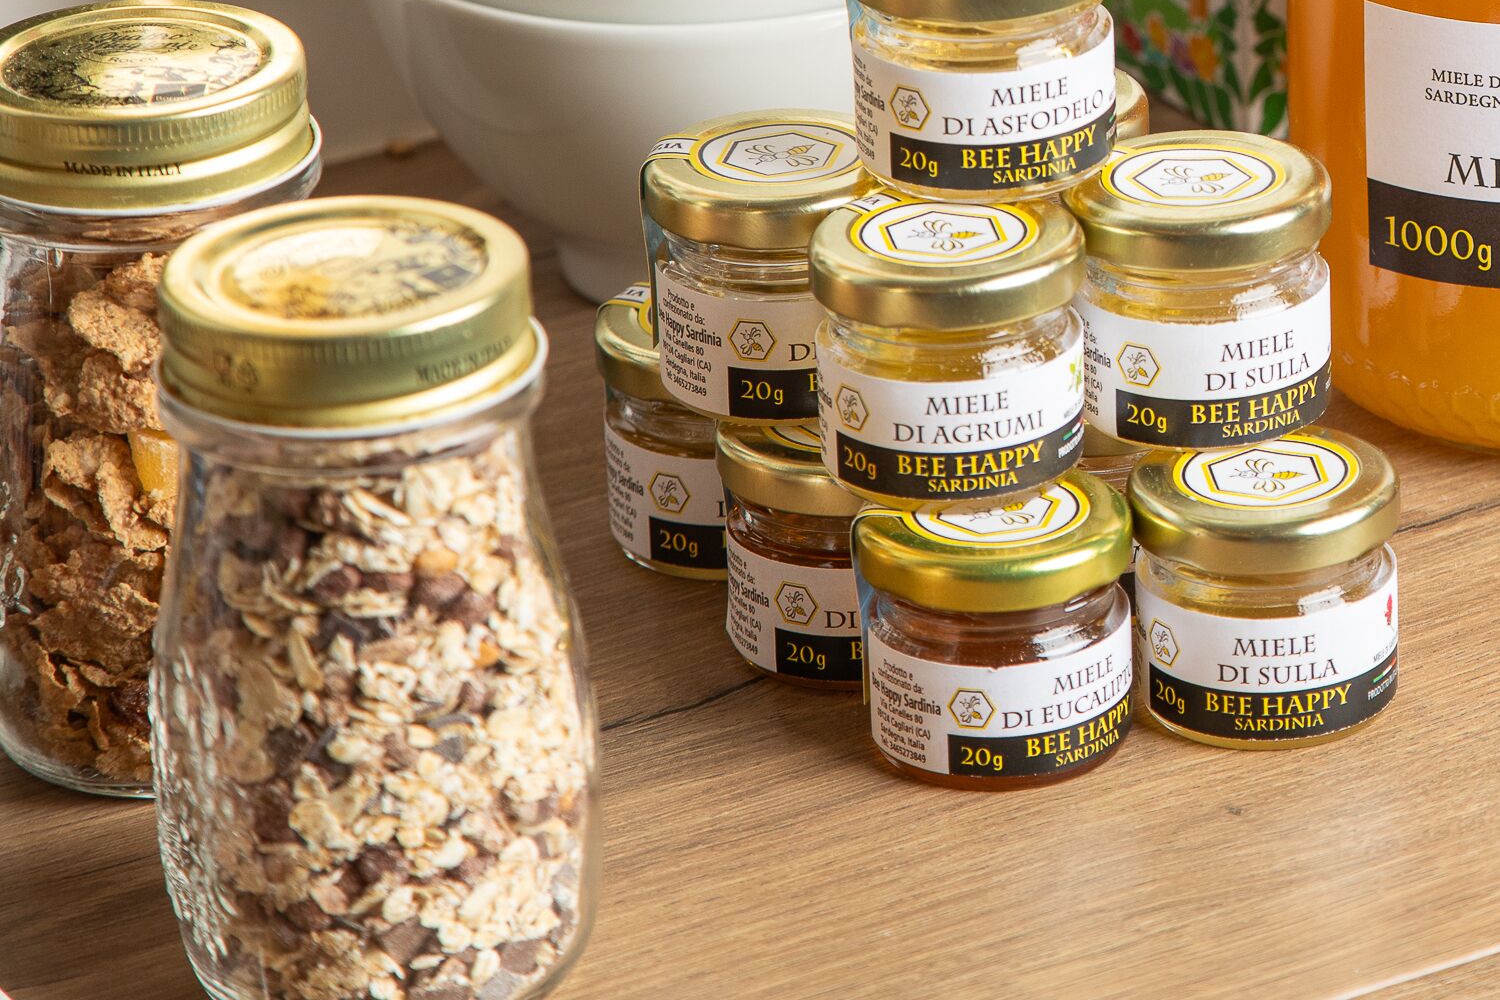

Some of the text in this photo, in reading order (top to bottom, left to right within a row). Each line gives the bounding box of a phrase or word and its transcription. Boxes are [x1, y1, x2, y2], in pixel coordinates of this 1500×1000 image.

[990, 76, 1068, 107] MIELE
[1431, 68, 1484, 88] MIELE
[943, 116, 973, 136] DI
[982, 89, 1104, 137] ASFODELO
[900, 147, 938, 177] 20g
[961, 147, 1011, 169] BEE
[1020, 124, 1097, 164] HAPPY
[64, 161, 181, 177] MADE IN ITALY
[993, 156, 1077, 184] SARDINIA
[1383, 215, 1492, 270] 1000g
[686, 324, 722, 347] Sardinia
[1220, 330, 1294, 362] MIELE
[695, 346, 704, 356] 80
[690, 370, 706, 383] Italia
[697, 359, 712, 373] (CA)
[1205, 352, 1310, 391] DI SULLA
[741, 379, 784, 405] 20g
[925, 390, 1008, 416] MIELE
[1127, 377, 1319, 432] 20g BEE HAPPY
[893, 422, 923, 442] DI
[934, 410, 1045, 445] AGRUMI
[1222, 411, 1300, 438] SARDINIA
[844, 447, 877, 479] 20g
[898, 453, 947, 476] BEE
[955, 440, 1044, 475] HAPPY
[928, 471, 1018, 492] SARDINIA
[660, 530, 698, 557] 20g
[740, 581, 770, 608] Sardinia
[824, 610, 857, 629] DI
[787, 642, 826, 670] 20g
[1231, 634, 1316, 657] MIELE
[1052, 654, 1114, 696] MIELE
[1217, 658, 1338, 686] DI SULLA
[880, 681, 902, 707] Happy
[904, 694, 942, 716] Sardinia
[1155, 680, 1352, 716] 20g BEE HAPPY
[914, 715, 924, 725] 80
[916, 727, 931, 740] (CA)
[960, 695, 1130, 771] 20g BEE HAPPY
[1002, 710, 1032, 730] DI
[1234, 713, 1324, 731] SARDINIA
[908, 737, 925, 750] Italia
[1055, 731, 1119, 768] SARDINIA
